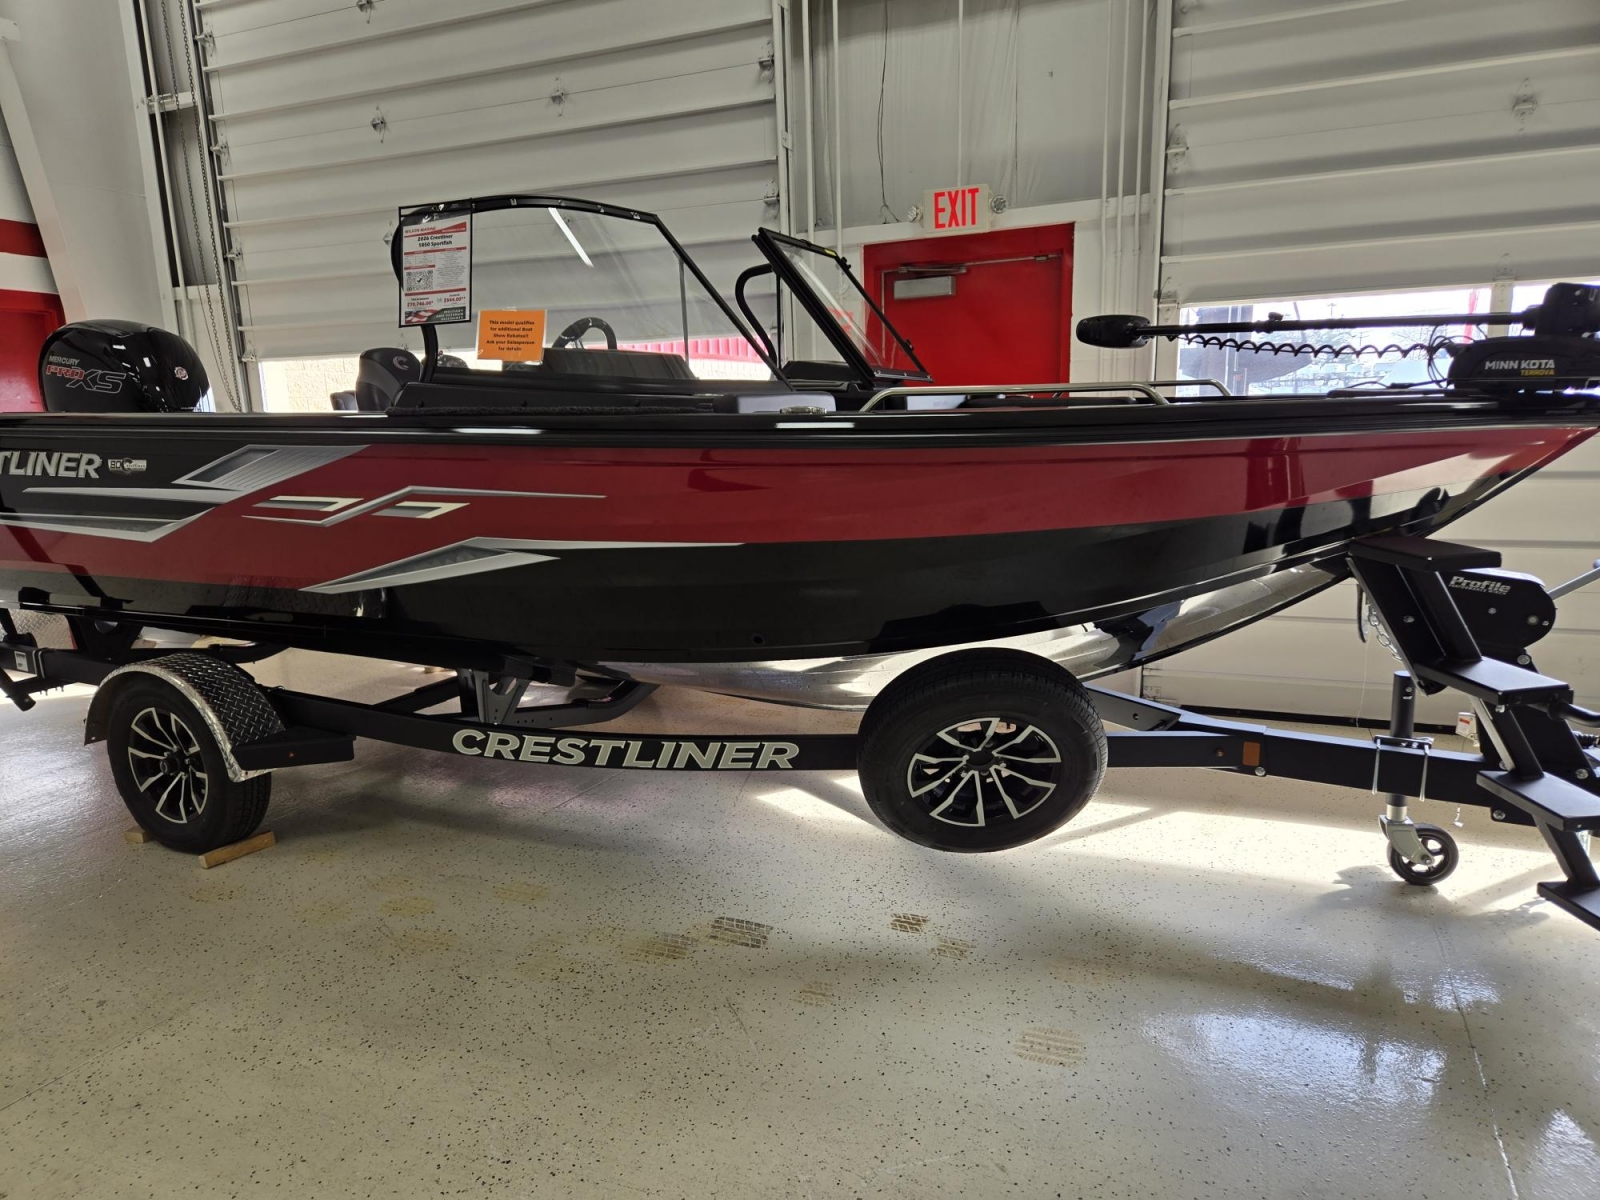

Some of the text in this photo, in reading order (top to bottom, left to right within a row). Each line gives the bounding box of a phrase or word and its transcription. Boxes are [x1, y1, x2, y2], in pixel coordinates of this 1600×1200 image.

[934, 187, 979, 229] EXIT
[49, 355, 80, 366] MERCURY
[1485, 359, 1555, 370] MINN KOTA
[46, 364, 127, 394] PRO XS
[1450, 576, 1511, 592] Profile
[452, 728, 800, 770] CRESTLINER
